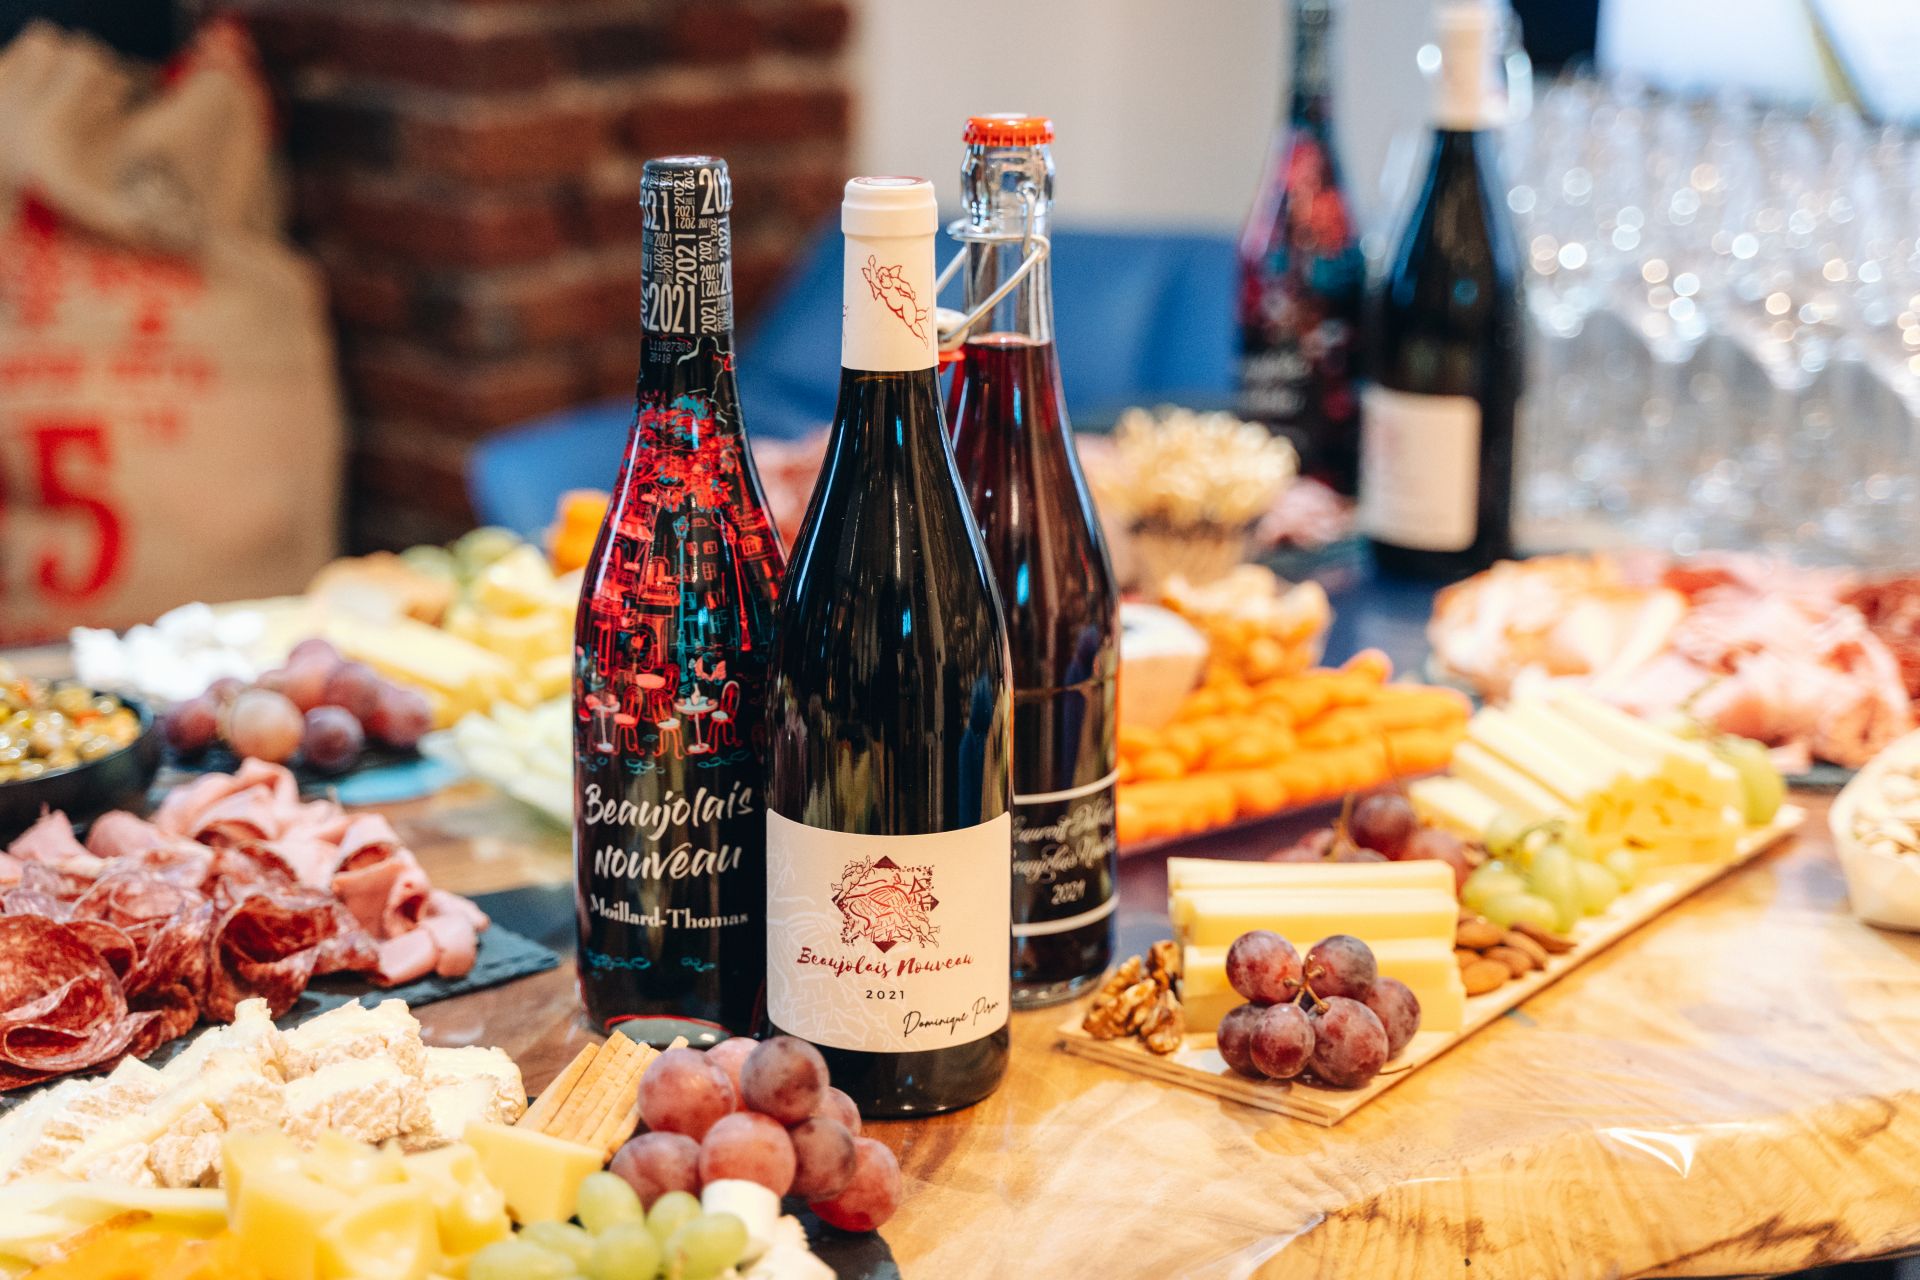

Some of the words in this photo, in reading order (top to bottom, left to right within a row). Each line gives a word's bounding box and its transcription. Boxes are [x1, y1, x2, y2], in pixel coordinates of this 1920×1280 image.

[673, 173, 685, 205] 2021
[684, 169, 695, 196] 2021
[674, 205, 695, 218] 2021
[675, 217, 696, 230] 2021
[654, 232, 672, 247] 2021
[699, 235, 713, 262] 2021
[675, 233, 698, 285] 2021
[700, 263, 720, 281] 2021
[648, 282, 696, 334] 2021
[700, 299, 718, 334] 2021
[584, 781, 754, 842] Beaujolais
[1051, 878, 1086, 906] 2021
[589, 893, 749, 929] Moillard-Thomas
[797, 946, 892, 979] Beaujolais
[896, 954, 975, 977] Nouveau
[865, 989, 905, 1000] 2021
[903, 1010, 968, 1038] Dominique
